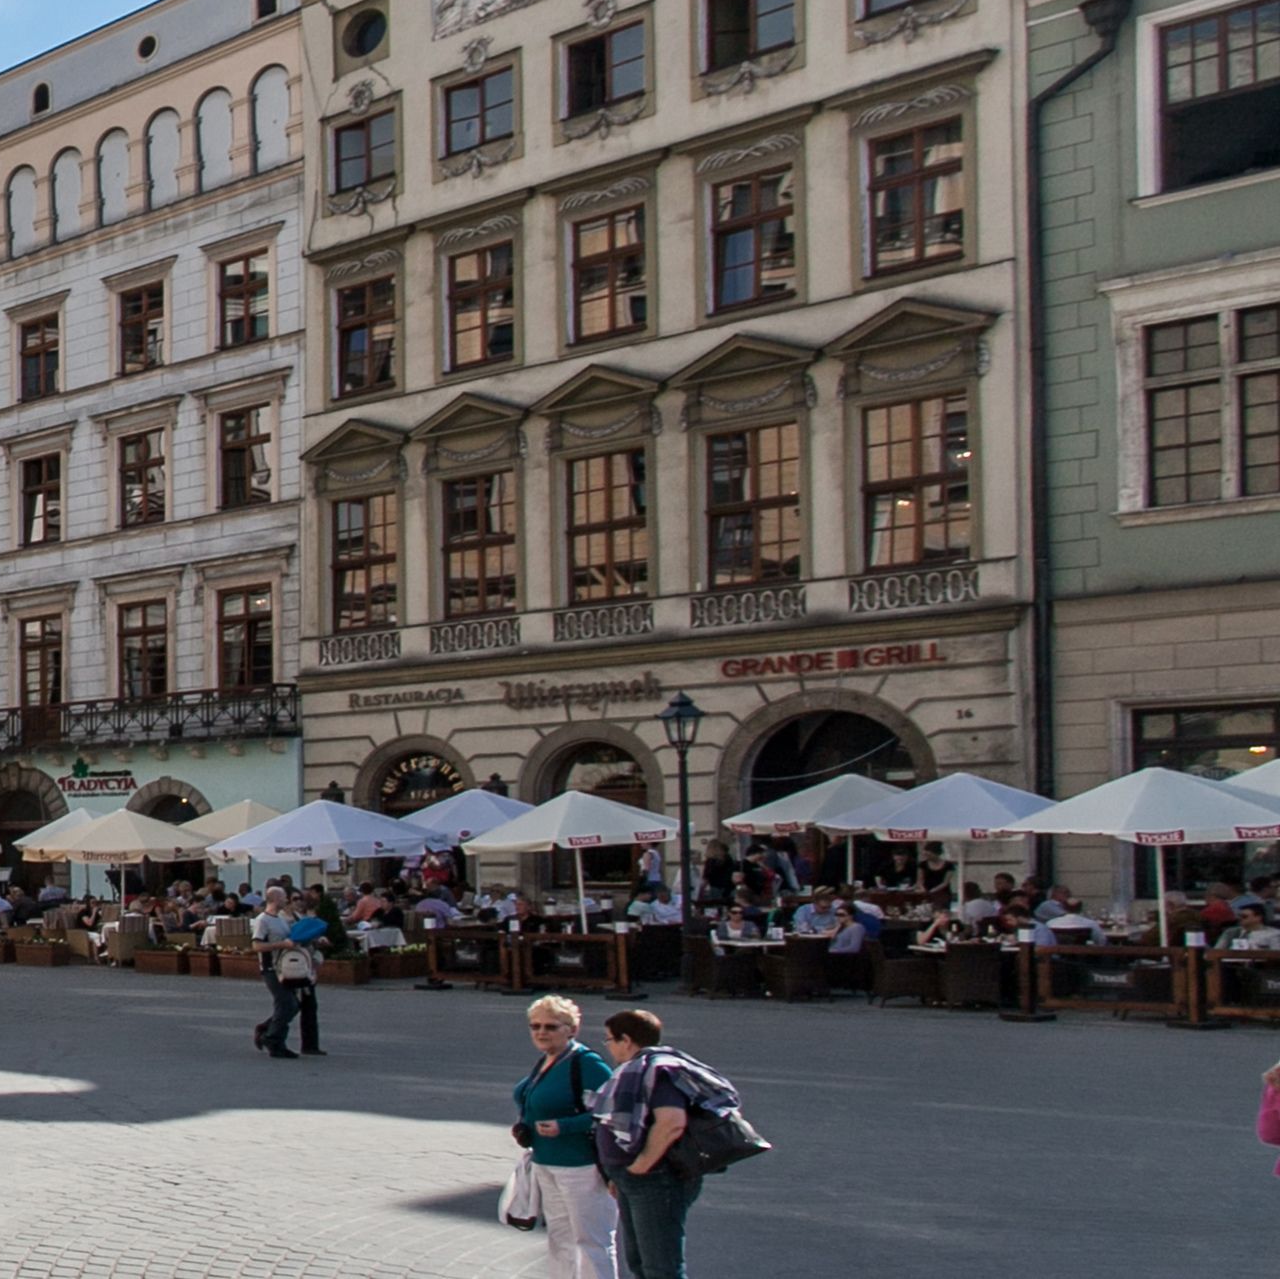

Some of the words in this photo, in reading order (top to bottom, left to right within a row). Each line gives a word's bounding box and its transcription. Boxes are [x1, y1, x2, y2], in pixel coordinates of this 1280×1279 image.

[721, 651, 834, 677] GRANDE
[863, 642, 946, 666] GRILL
[498, 670, 662, 712] Wierzynek
[956, 708, 974, 719] 16
[891, 830, 925, 839] TYSKIE
[1140, 832, 1182, 843] TYSKIE
